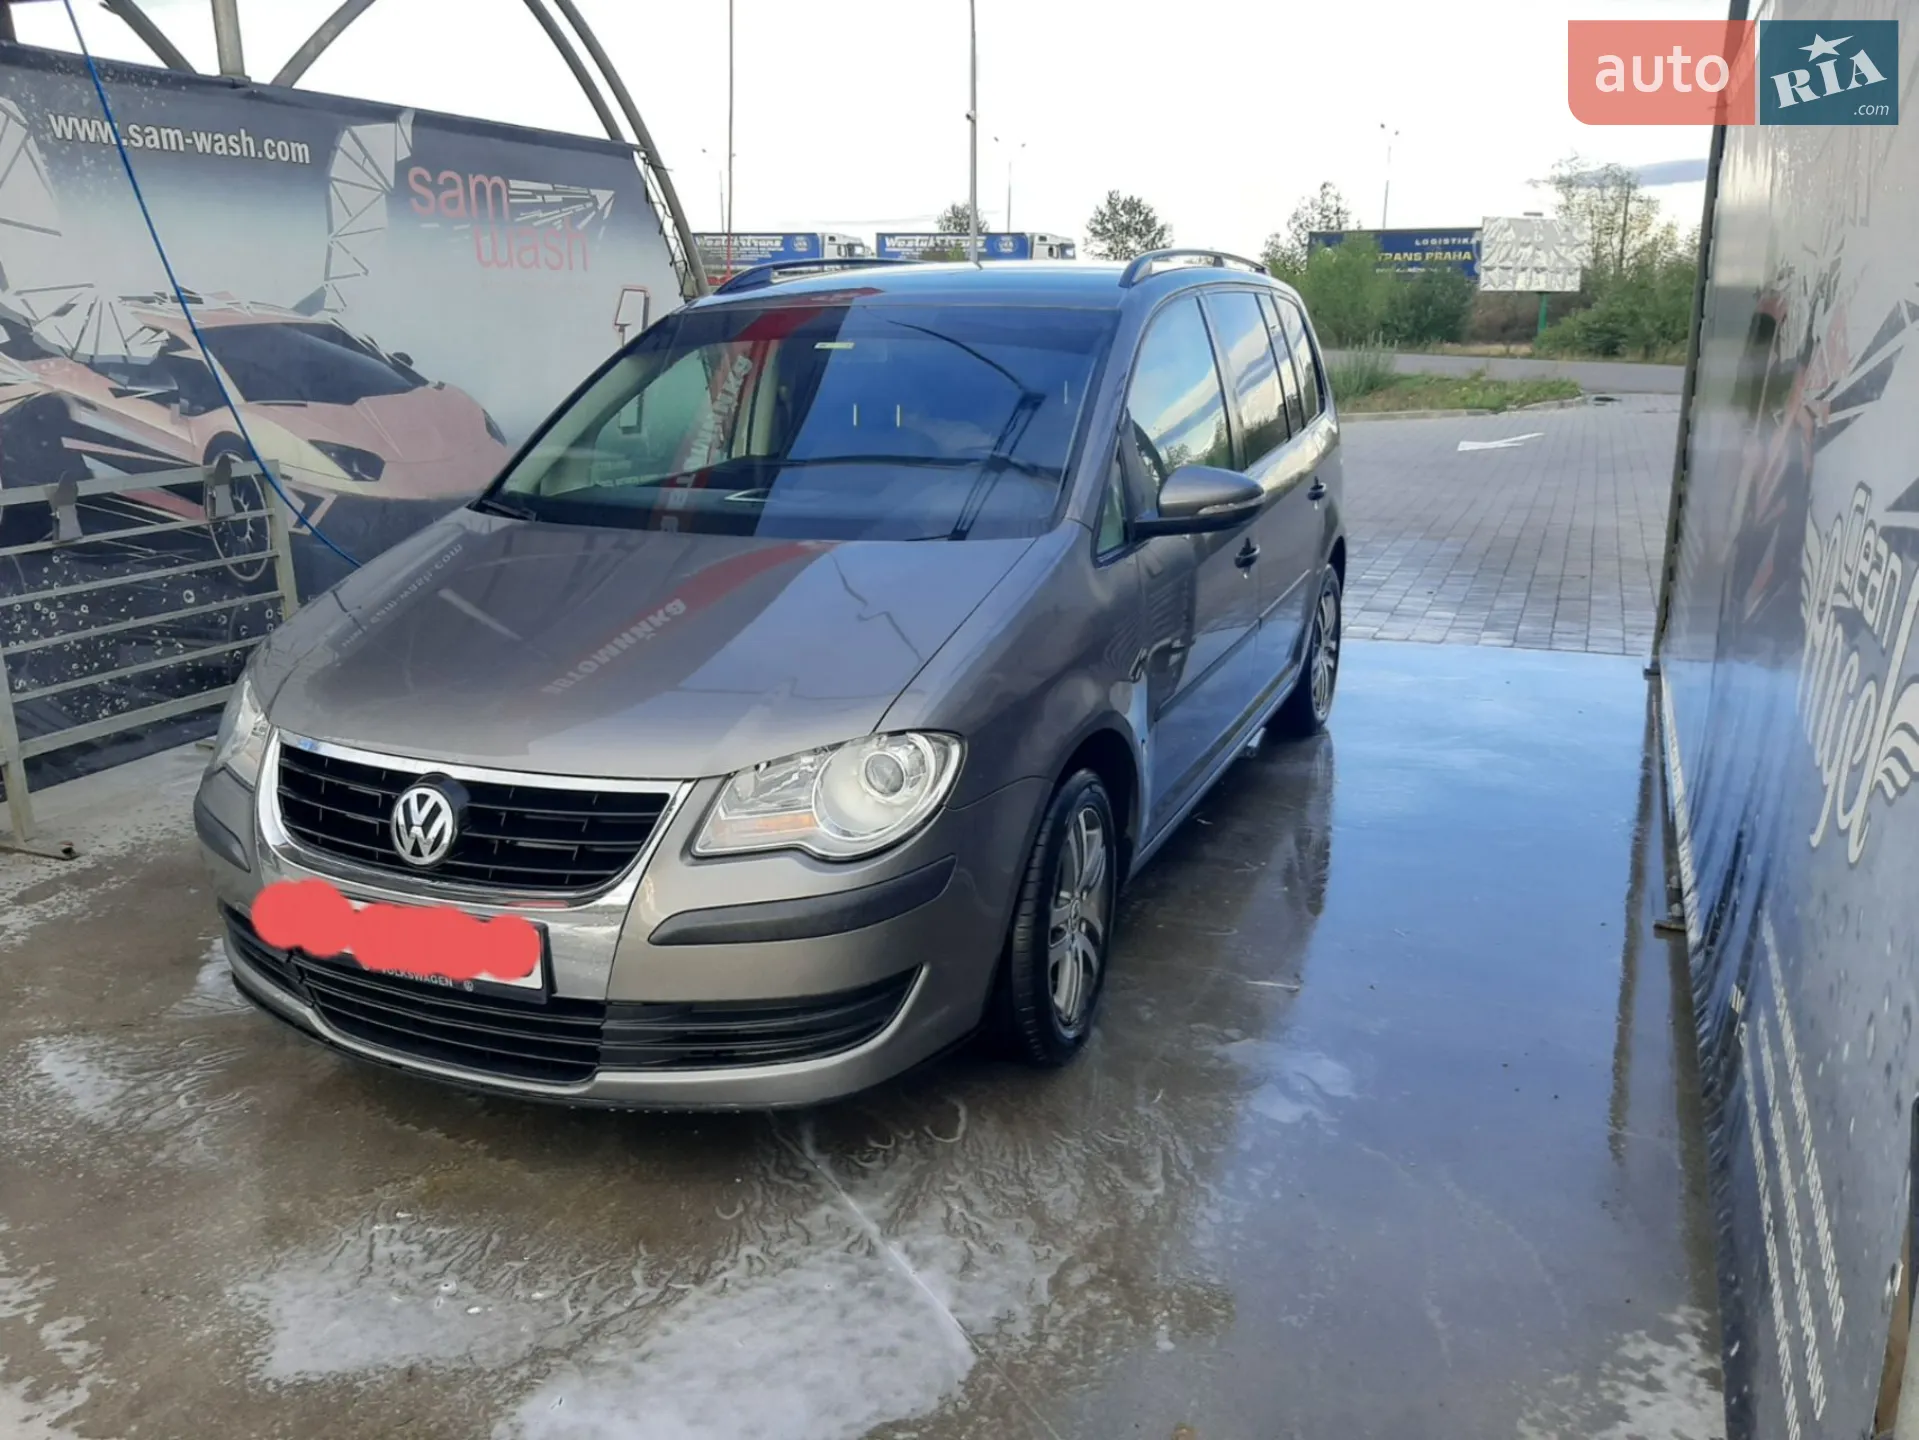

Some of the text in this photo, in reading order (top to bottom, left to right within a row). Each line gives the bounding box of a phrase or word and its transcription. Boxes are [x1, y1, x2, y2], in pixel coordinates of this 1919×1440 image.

[48, 113, 311, 164] www.sam-wash.com
[407, 165, 510, 222] sam
[472, 215, 592, 272] wash
[1377, 251, 1473, 262] TRANS PRAHA
[381, 967, 454, 988] VOLKSWAGEN
[1796, 1267, 1828, 1421] ПОРЯДКУ
